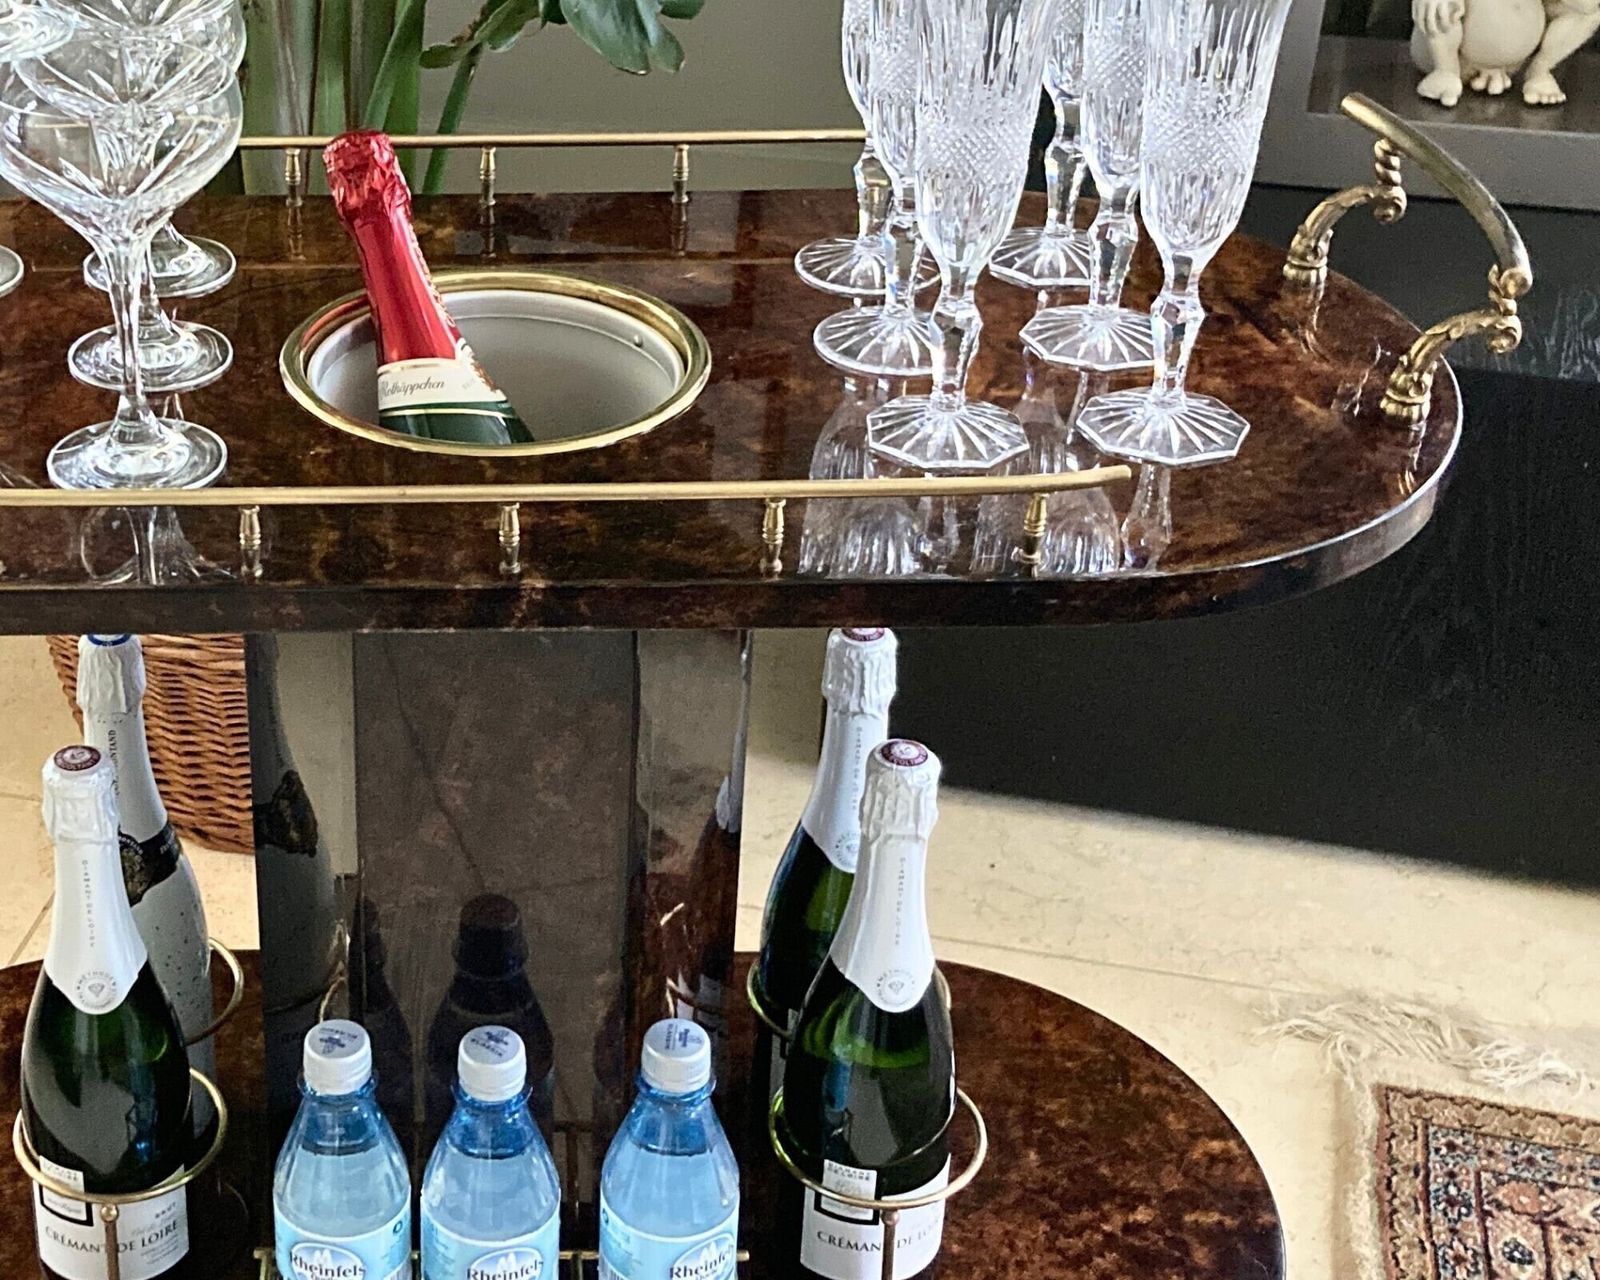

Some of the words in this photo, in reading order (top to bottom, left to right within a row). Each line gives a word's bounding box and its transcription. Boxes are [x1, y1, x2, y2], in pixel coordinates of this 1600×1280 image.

[82, 860, 91, 899] DIAMANT
[86, 903, 93, 915] DE
[117, 1240, 137, 1253] DE
[141, 1220, 178, 1248] LOIRE
[817, 1230, 882, 1252] CRÉMAN
